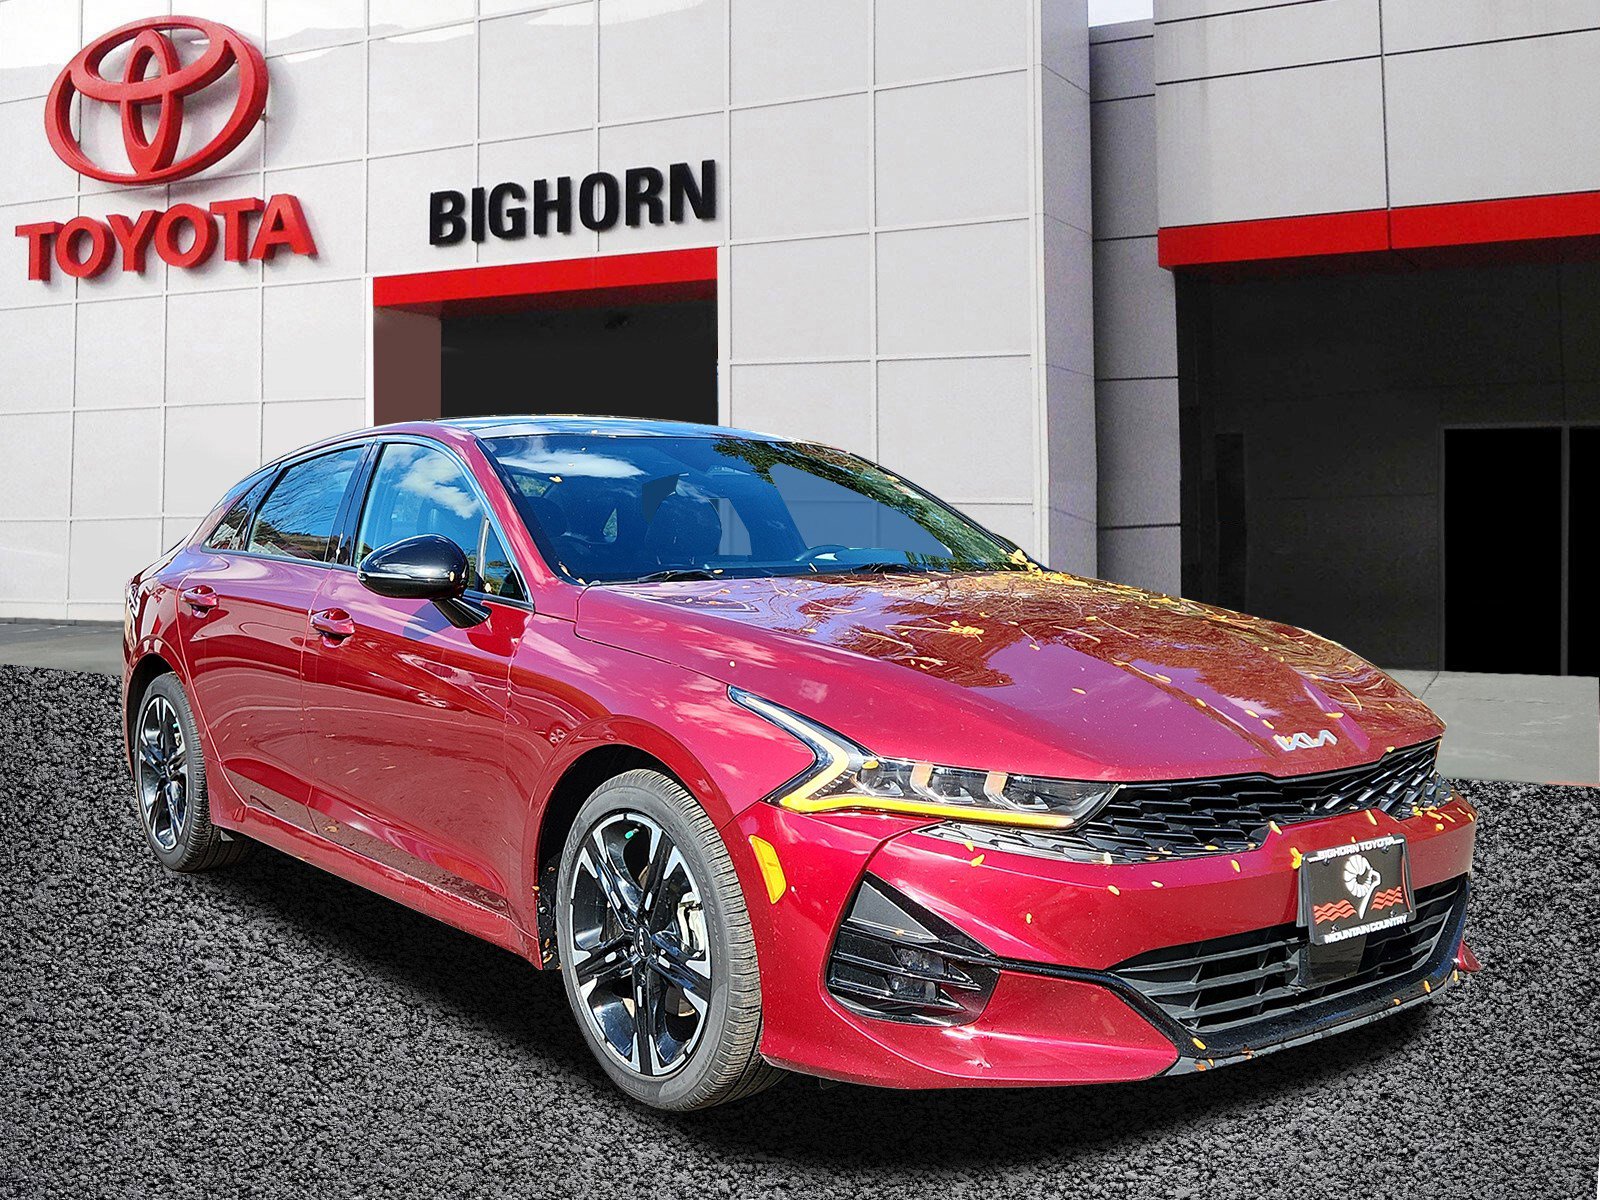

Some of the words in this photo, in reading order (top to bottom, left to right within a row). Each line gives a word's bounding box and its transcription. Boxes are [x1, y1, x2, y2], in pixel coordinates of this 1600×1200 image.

[429, 160, 717, 246] BIGHORN
[15, 194, 318, 281] TOYOTA
[1317, 843, 1360, 859] BIGHORN
[1359, 836, 1395, 851] TOYOTA
[1324, 924, 1371, 944] MOUNTAIN
[1370, 914, 1408, 931] COUNTRY
